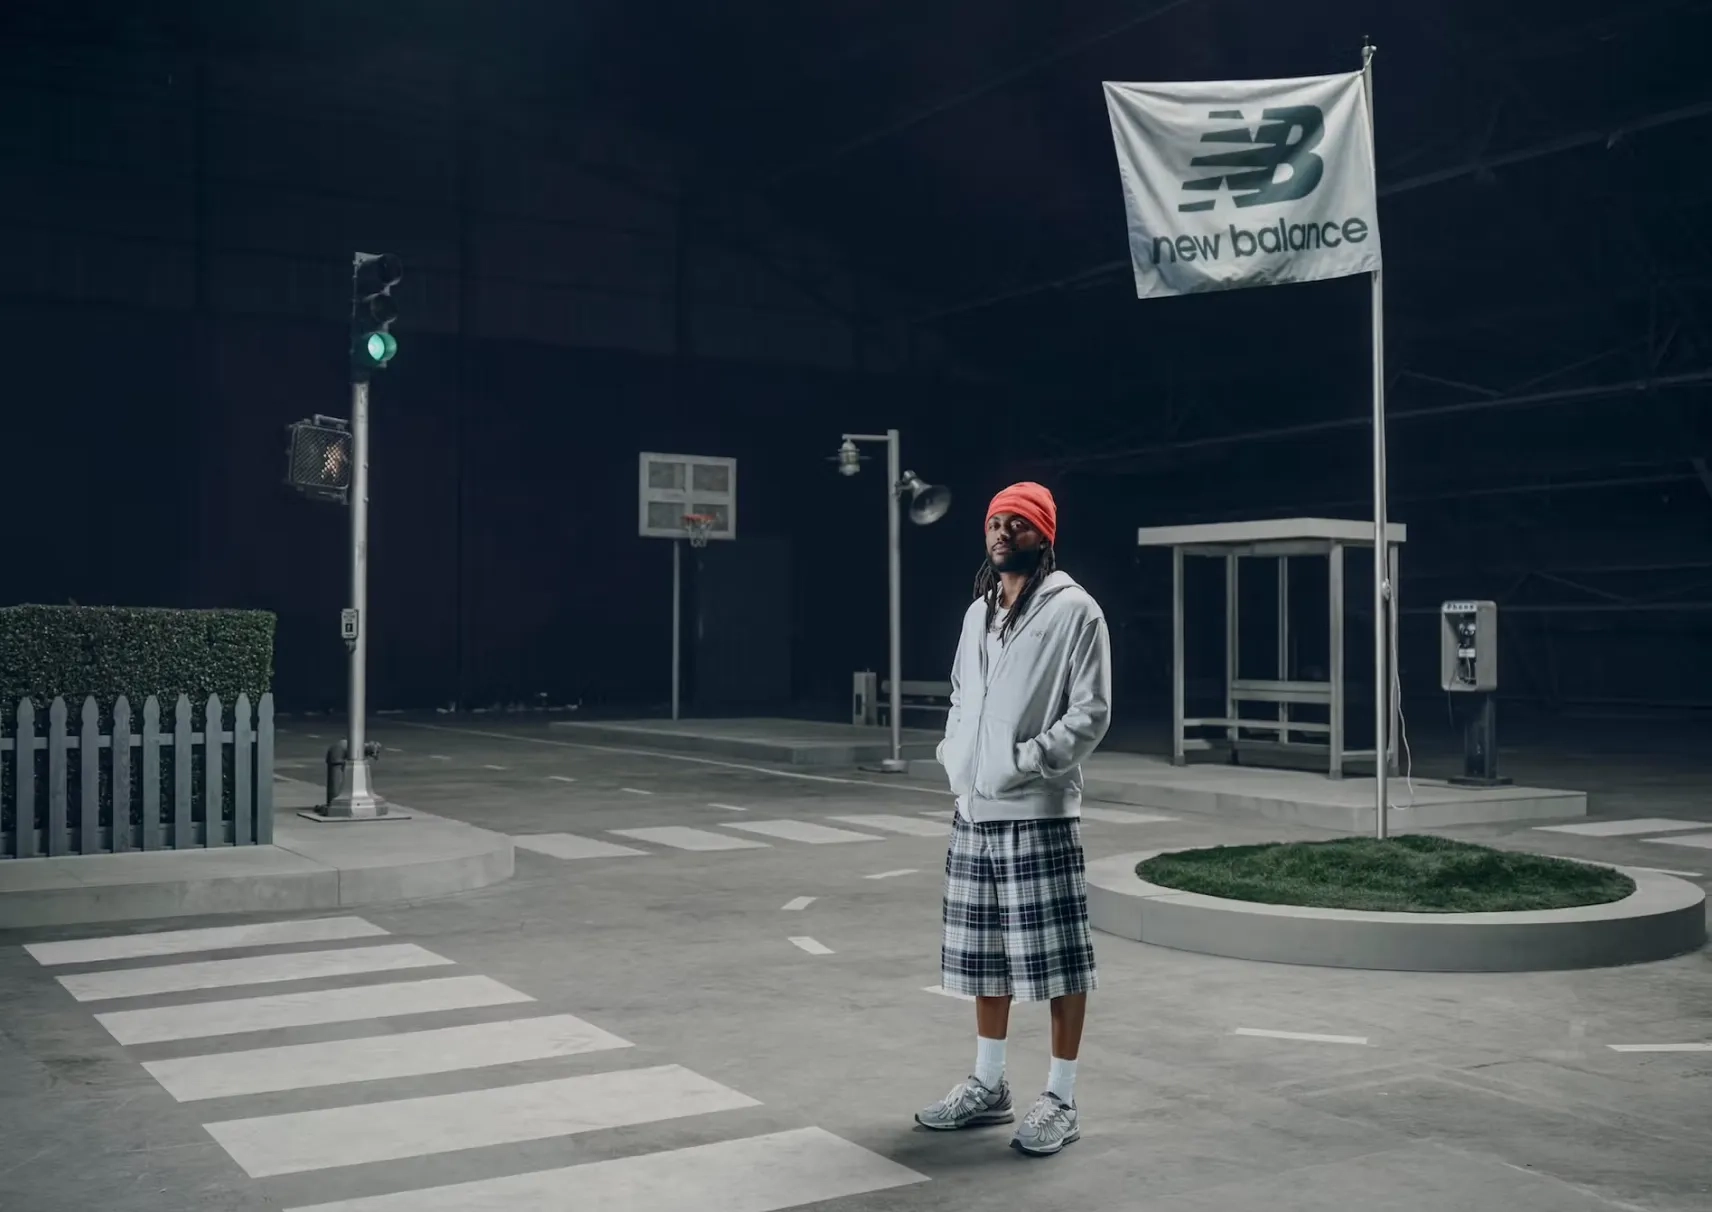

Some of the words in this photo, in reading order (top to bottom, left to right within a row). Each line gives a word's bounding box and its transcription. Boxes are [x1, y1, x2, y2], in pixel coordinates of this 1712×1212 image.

[1178, 104, 1325, 213] NB
[1152, 232, 1221, 265] new
[1229, 217, 1368, 257] balance
